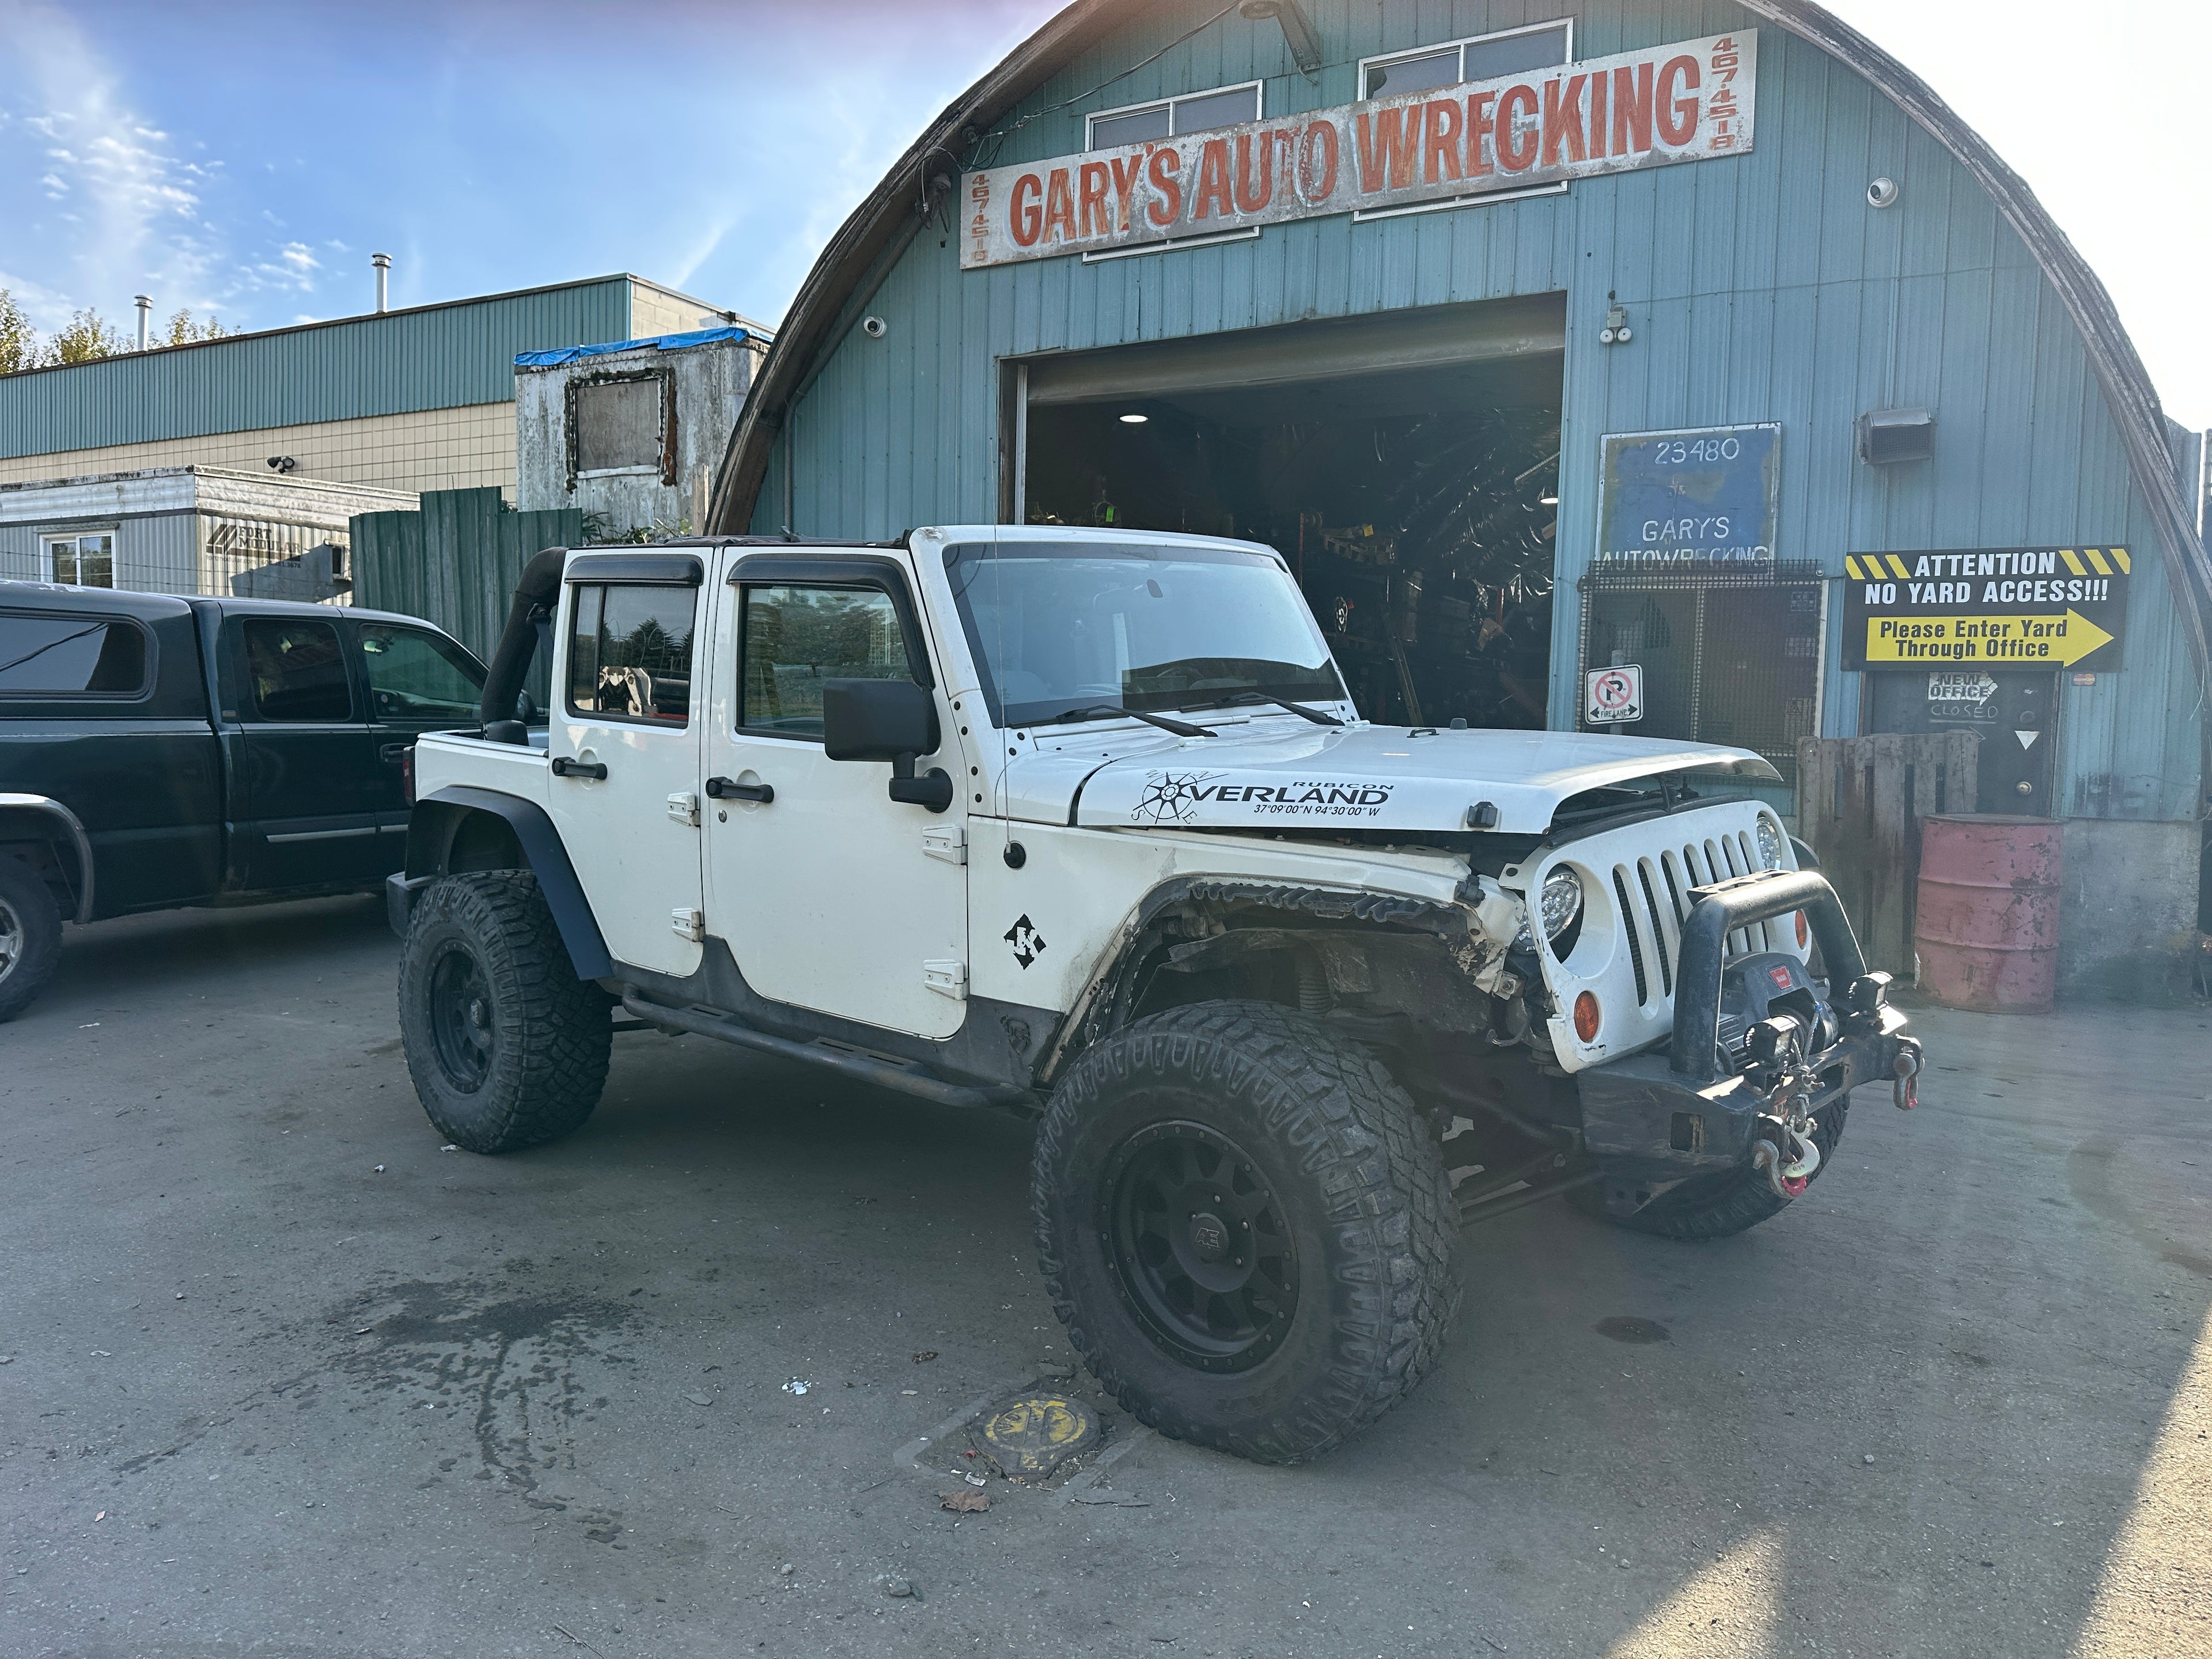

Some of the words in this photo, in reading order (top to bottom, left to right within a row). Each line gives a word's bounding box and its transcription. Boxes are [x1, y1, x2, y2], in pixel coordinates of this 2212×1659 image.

[1010, 144, 1181, 247] GARY'S
[1196, 120, 1338, 219] AUTO
[1357, 55, 1700, 194] WRECKING
[1655, 438, 1740, 464] 23480
[238, 526, 272, 539] FORT
[1642, 516, 1730, 541] GARY'S
[239, 537, 301, 554] MODULAR
[1914, 552, 2055, 577] ATTENTION
[1865, 583, 1896, 604] NO
[1908, 581, 1971, 604] YARD
[1982, 579, 2108, 603] ACCESS!!!
[1881, 621, 1945, 638] Please
[1955, 620, 2010, 638] Enter
[2021, 619, 2067, 637] Yard
[1895, 640, 1976, 660] Through
[1986, 639, 2049, 657] Office
[1940, 674, 1979, 685] NEW
[1930, 685, 1989, 698] OFFICE
[1293, 782, 1394, 790] RUBICON
